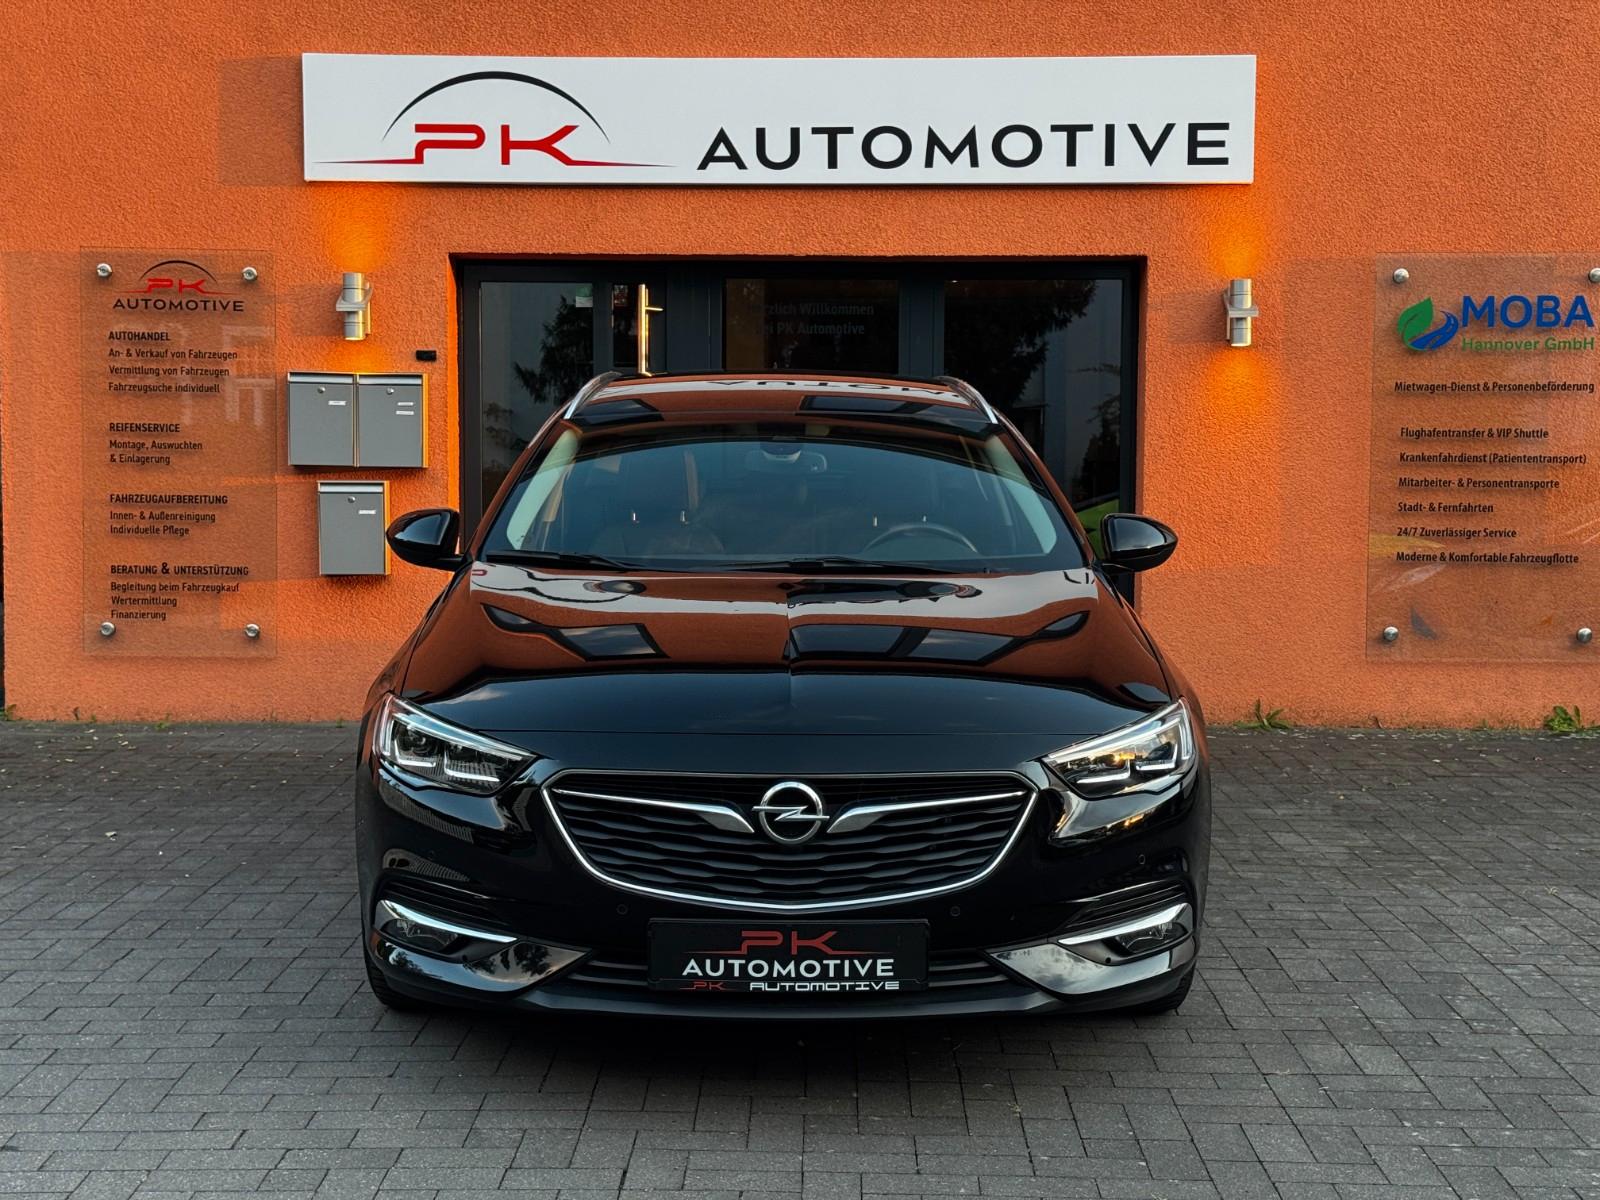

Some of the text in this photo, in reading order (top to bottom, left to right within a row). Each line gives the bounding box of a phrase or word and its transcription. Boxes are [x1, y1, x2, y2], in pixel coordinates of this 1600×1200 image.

[413, 121, 1230, 172] PK AUTOMOTIVE
[148, 277, 208, 295] PK
[112, 298, 244, 312] AUTOMOTIVE
[752, 303, 874, 316] rzlich Willkommen
[1461, 294, 1595, 329] MOBA
[776, 323, 794, 335] PK
[797, 322, 866, 336] Automotive
[108, 331, 170, 342] AUTOHANDEL
[1461, 336, 1595, 351] Hannover GmbH
[108, 348, 238, 361] An- & Verkauf von Fahrzeugen
[108, 365, 230, 378] Vermittlung von Fahrzeugen
[108, 382, 220, 394] Fahrzeugsuche individuell
[1394, 381, 1595, 394] Mietwagen-Dienst & Personenbeförderung
[109, 422, 181, 433] REIFENSERVICE
[1400, 427, 1549, 439] Flughafentransfer & VIP Shuttle
[109, 440, 203, 451] Montage, Auswuchten
[110, 454, 171, 466] & Einlagerung
[1399, 452, 1587, 465] Krankenfahrdienst (Patiententransport)
[1398, 477, 1560, 490] Mitarbeiter- & Personentransporte
[109, 493, 228, 505] FAHRZEUGAUFBEREITUNG
[1397, 502, 1494, 513] Stadt- & Fernfahrten
[110, 511, 216, 523] Innen- & Außenreinigung
[110, 525, 190, 537] Individuelle Pflege
[1397, 527, 1517, 539] 24/7 Zuverlässiger Service
[1396, 552, 1579, 565] Moderne & Komfortable Fahrzeugflotte
[110, 562, 249, 576] BERATUNG & UNTERSTÜTZUNG
[110, 582, 240, 594] Begleitung beim Fahrzeugkauf
[111, 596, 177, 607] Wertermittlung
[111, 609, 167, 621] Finanzierung
[740, 930, 838, 955] PK
[681, 958, 895, 978] AUTOMOTIVE
[692, 981, 899, 992] PK AUTOMOTIVE
